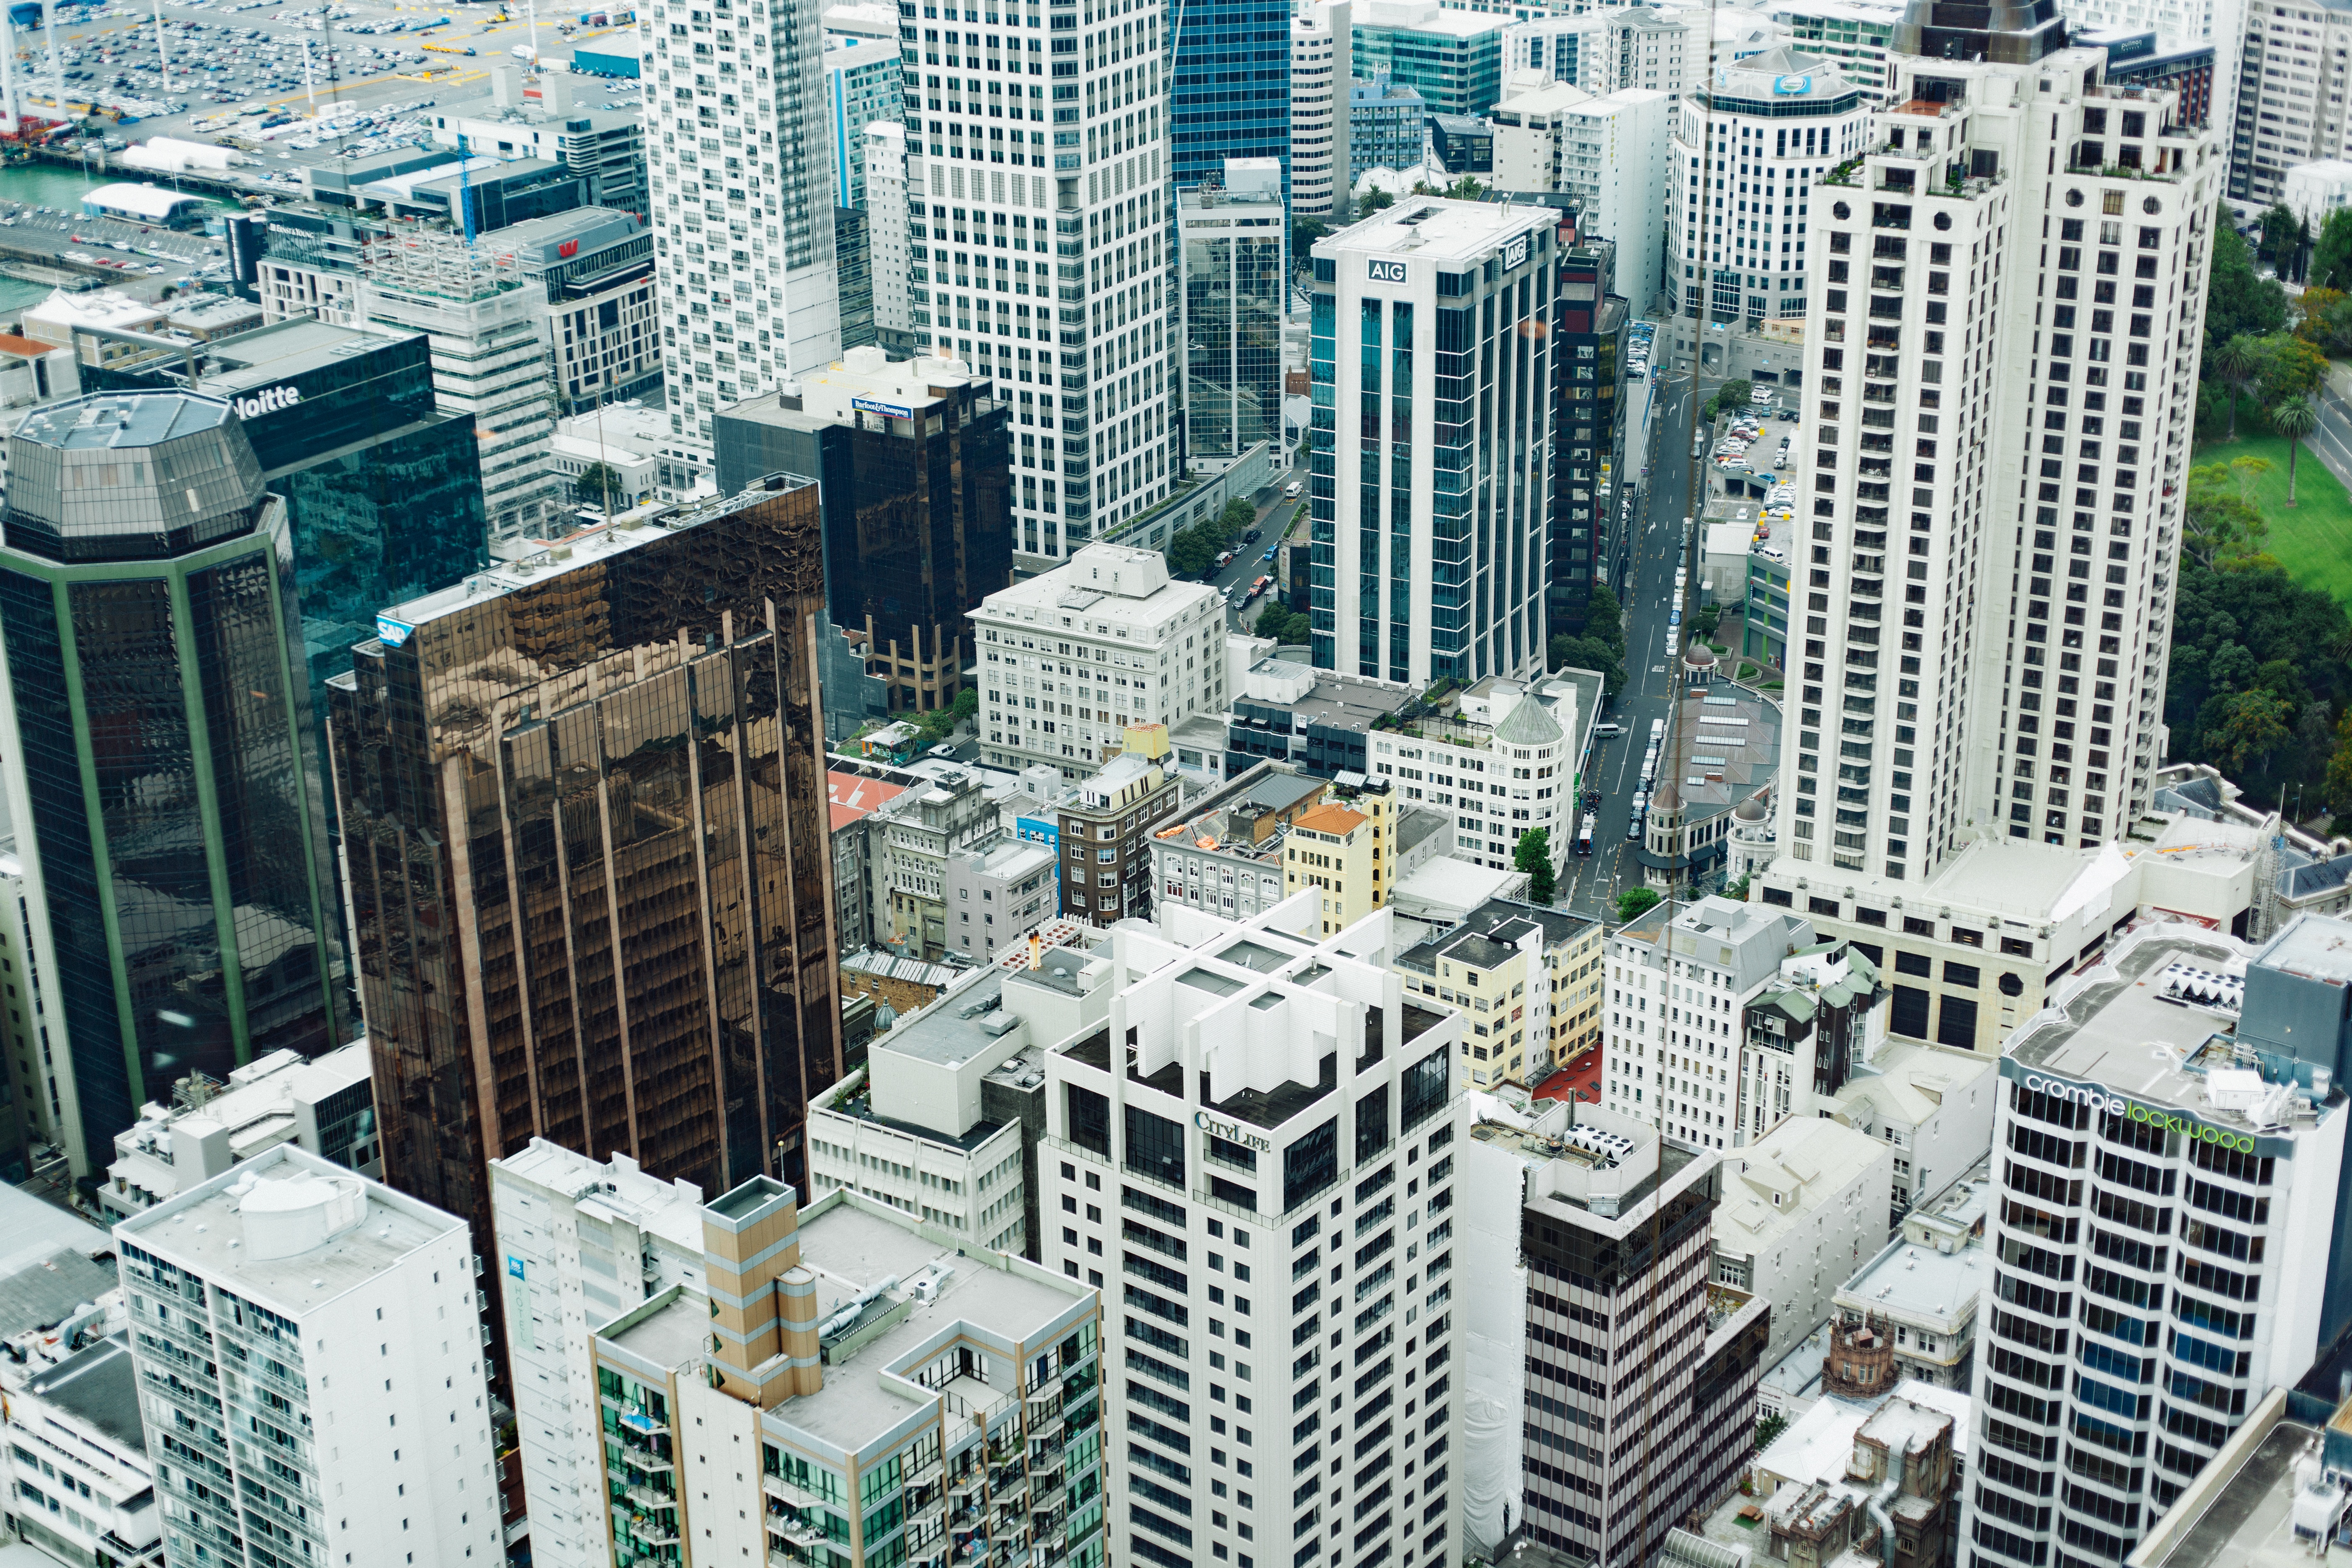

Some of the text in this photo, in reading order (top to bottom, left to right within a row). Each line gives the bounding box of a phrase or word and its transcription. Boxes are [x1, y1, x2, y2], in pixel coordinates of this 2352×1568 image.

[2121, 39, 2142, 50] pullman
[1509, 242, 1524, 264] AIG
[1371, 263, 1404, 281] AIG
[377, 621, 405, 644] SAP
[2026, 1075, 2255, 1154] crombie lockwood
[515, 1285, 526, 1343] HOTEL
